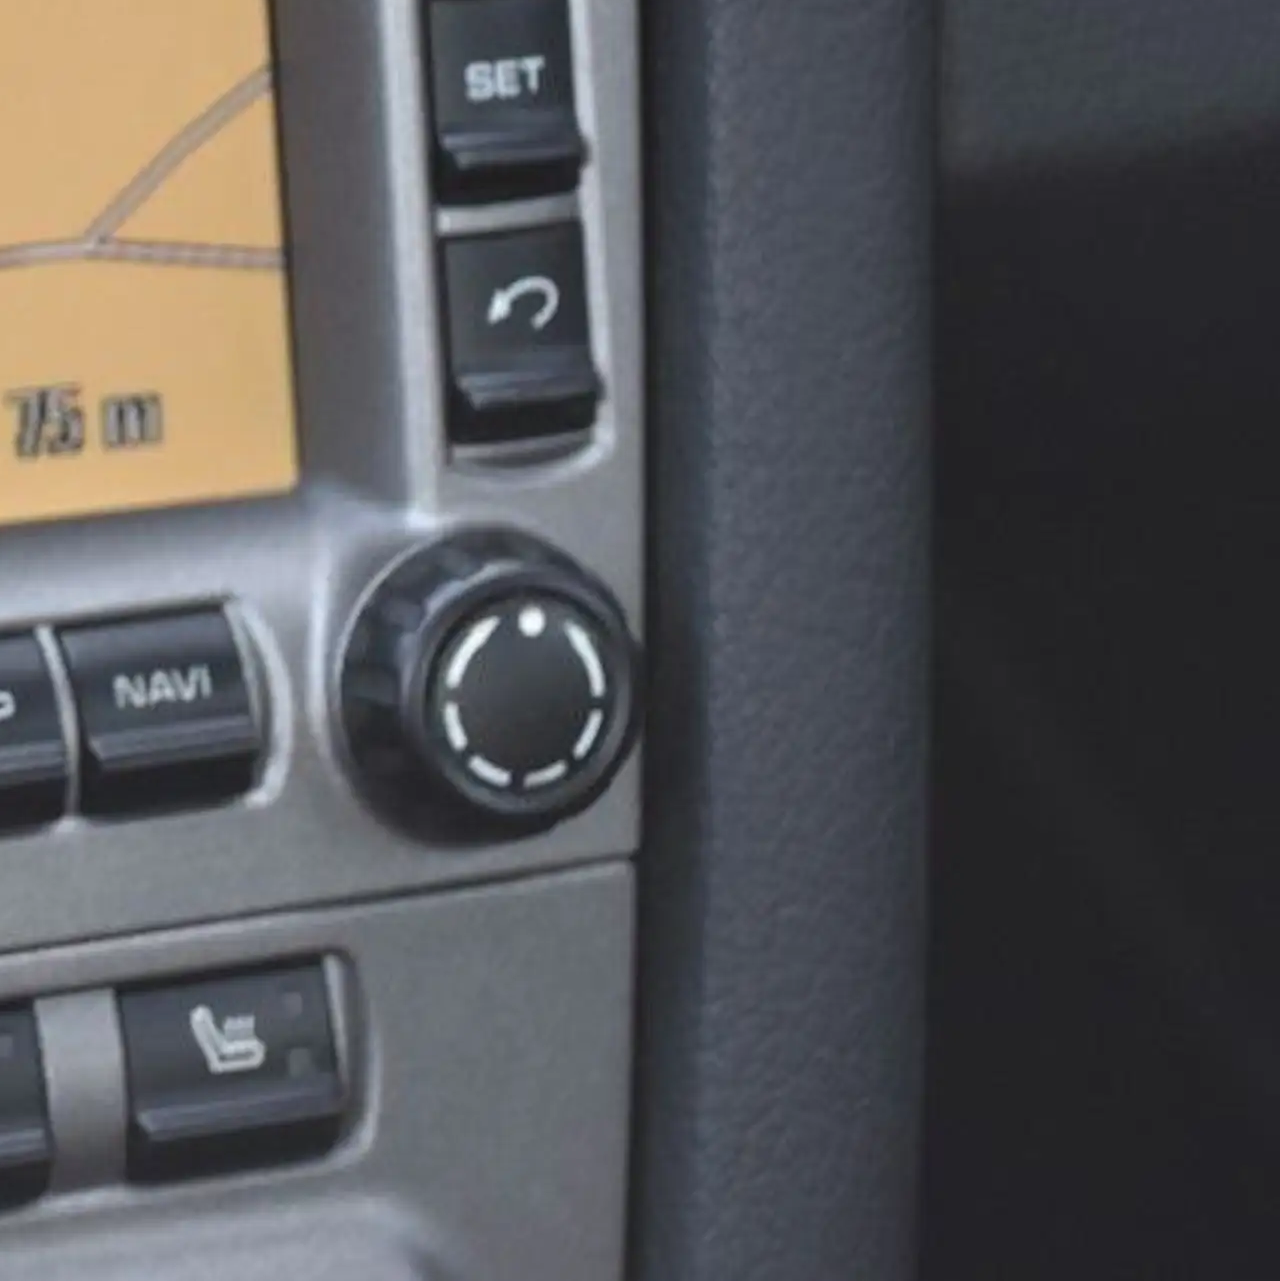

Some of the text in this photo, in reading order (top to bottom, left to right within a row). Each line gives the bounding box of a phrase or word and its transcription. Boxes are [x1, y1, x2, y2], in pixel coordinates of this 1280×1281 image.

[464, 55, 545, 102] SET
[2, 383, 164, 459] 75 m
[112, 666, 213, 709] NAVI
